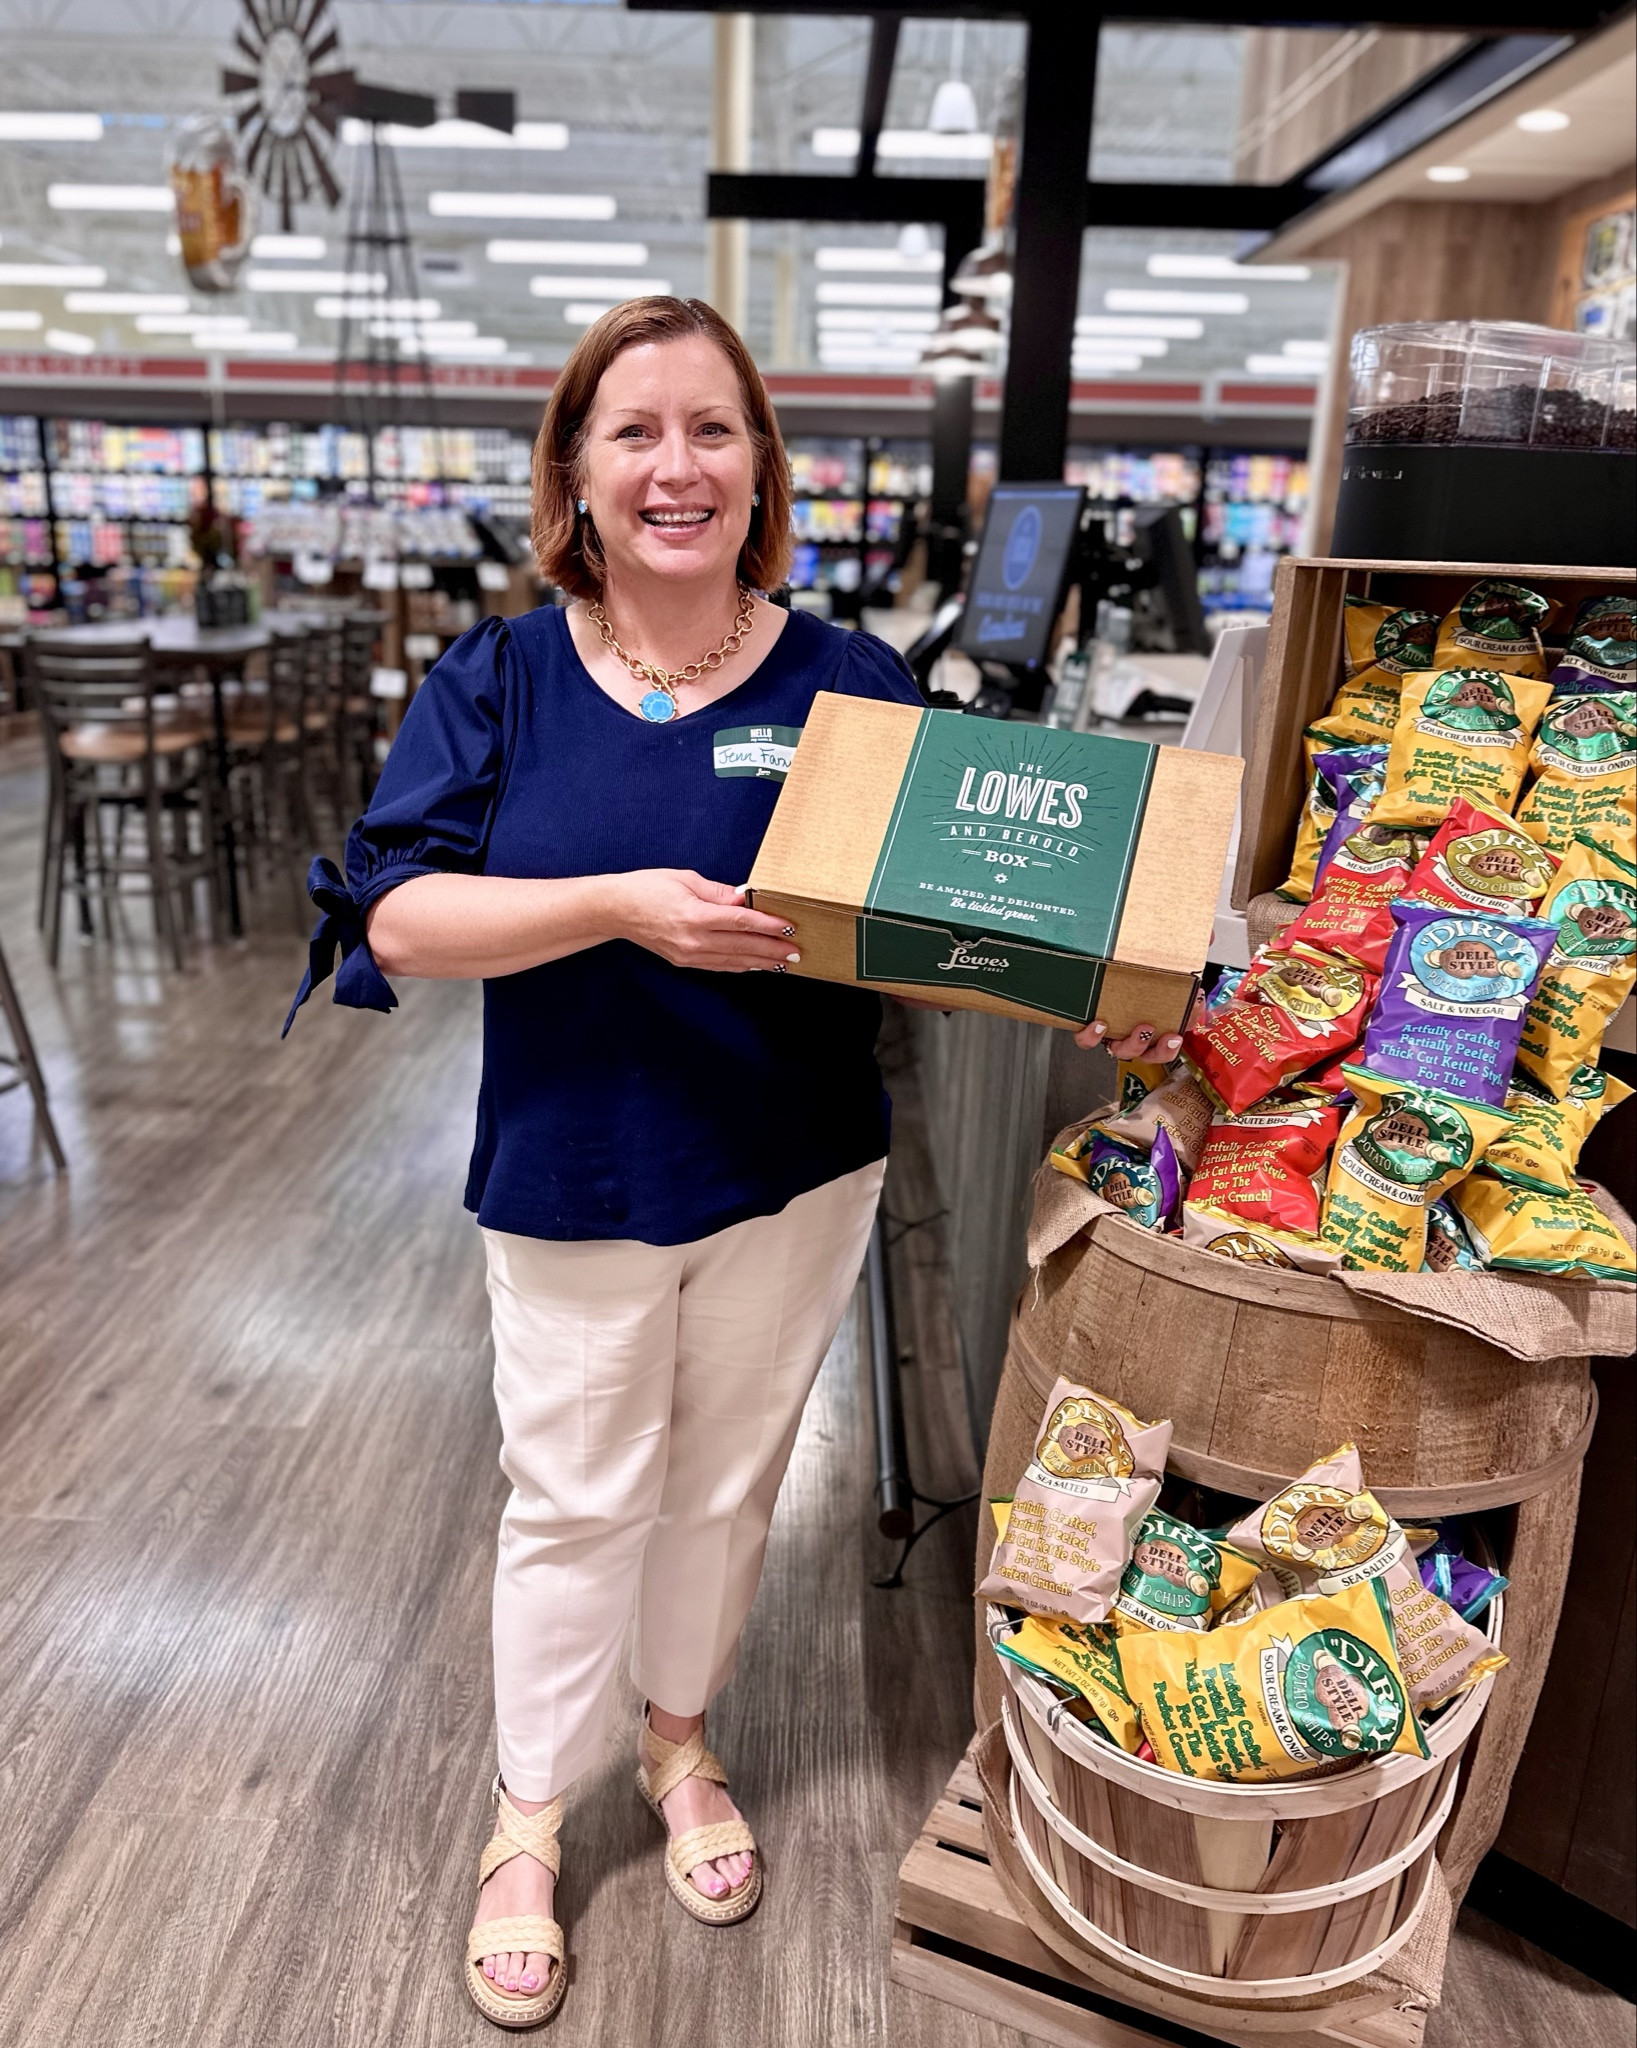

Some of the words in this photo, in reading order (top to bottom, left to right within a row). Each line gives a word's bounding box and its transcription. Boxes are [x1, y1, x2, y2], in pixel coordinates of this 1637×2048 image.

[1459, 636, 1481, 648] SOUR
[1481, 639, 1510, 652] CREAM
[1510, 644, 1518, 652] &
[1561, 655, 1580, 666] SALT
[1581, 663, 1589, 671] &
[1589, 665, 1628, 681] VINEGAR
[1475, 712, 1507, 726] CHIPS
[750, 728, 772, 738] HELLO
[1420, 724, 1444, 736] SOUR
[1445, 730, 1475, 744] CREAM
[1475, 735, 1482, 743] &
[1484, 736, 1512, 747] ONION
[718, 747, 757, 764] Jenn
[1413, 748, 1459, 766] Artfully
[1554, 735, 1593, 756] POTATO
[1019, 762, 1043, 774] THE
[1544, 756, 1566, 768] SOUR
[1567, 762, 1597, 774] CREAM
[1607, 757, 1637, 770] ONION
[955, 766, 1089, 829] LOWES
[950, 825, 987, 837] AND
[1002, 830, 1080, 857] BEHOLD
[984, 850, 1029, 868] BOX
[1346, 861, 1385, 874] MESQUITE
[1478, 862, 1520, 875] STYLE
[1485, 855, 1517, 865] DELI
[1455, 866, 1489, 890] POTATO
[1491, 882, 1526, 895] CHIPS
[918, 882, 934, 891] BE
[936, 885, 987, 900] AMAZED.
[990, 894, 1005, 903] BE
[1007, 897, 1078, 917] DELIGHTED.
[1328, 893, 1348, 904] Cut
[1444, 877, 1487, 904] MESQUITE
[1487, 900, 1510, 910] BBQ
[950, 896, 967, 909] Be
[967, 899, 1005, 916] tickled
[1002, 909, 1039, 923] green.
[1326, 905, 1345, 917] For
[1347, 907, 1367, 920] The
[1304, 918, 1339, 931] Perfect
[937, 947, 1010, 970] Lowes
[1449, 959, 1496, 970] STYLE
[1455, 950, 1490, 961] DELI
[1426, 970, 1470, 996] POTATO
[1472, 978, 1511, 997] CHIPS
[1420, 998, 1445, 1012] SALT
[1447, 1005, 1456, 1013] &
[1458, 1006, 1505, 1016] VINEGAR
[1221, 1026, 1239, 1043] The
[1402, 1024, 1451, 1040] Artfully
[1456, 1029, 1502, 1053] Crafted,
[1551, 1016, 1581, 1040] Style
[1208, 1033, 1243, 1067] Crunch!
[1254, 1039, 1278, 1064] Style
[1380, 1043, 1413, 1060] Thick
[1416, 1051, 1438, 1065] Cut
[1441, 1054, 1479, 1075] Kettle
[1400, 1034, 1451, 1055] Partially
[1455, 1043, 1498, 1067] Peeled,
[1416, 1066, 1440, 1081] For
[1444, 1071, 1466, 1088] The
[1378, 1129, 1426, 1149] STYLE
[1387, 1119, 1424, 1137] DELI
[1201, 1149, 1242, 1167] Partially
[1205, 1140, 1243, 1153] Artfully
[1357, 1137, 1392, 1171] POTATO
[1394, 1162, 1434, 1177] CHIPS
[1211, 1165, 1229, 1177] Cut
[1230, 1161, 1261, 1174] Kettle
[1262, 1161, 1287, 1181] Style
[1341, 1155, 1365, 1177] SOUR
[1363, 1171, 1392, 1197] CREAM
[1391, 1188, 1399, 1198] &
[1109, 1180, 1128, 1192] DELI
[1212, 1179, 1230, 1191] For
[1232, 1176, 1251, 1188] The
[1227, 1189, 1273, 1204] Crunch!
[1532, 1216, 1579, 1231] Perfect
[1551, 1205, 1575, 1217] For
[1576, 1207, 1595, 1220] The
[1368, 1211, 1413, 1242] Crafted,
[1322, 1225, 1346, 1245] Cut
[1343, 1236, 1381, 1264] Kettle
[1362, 1227, 1403, 1258] Peeled,
[1074, 1430, 1106, 1448] DELI
[1035, 1473, 1053, 1486] SEA
[1054, 1479, 1089, 1495] SALTED
[1012, 1498, 1048, 1520] Artfully
[1050, 1508, 1097, 1539] Crafted,
[1305, 1511, 1336, 1539] DELI
[1010, 1514, 1047, 1537] Partially
[1047, 1524, 1089, 1553] Peeled,
[1355, 1523, 1381, 1560] CHIPS
[1015, 1551, 1034, 1566] For
[1036, 1556, 1055, 1574] The
[1017, 1533, 1036, 1550] Cut
[1037, 1538, 1068, 1561] Kettle
[1070, 1552, 1102, 1574] Style
[1139, 1554, 1185, 1577] STYLE
[1148, 1545, 1182, 1564] DELI
[1341, 1571, 1363, 1588] SEA
[1363, 1551, 1396, 1578] SALTED
[1030, 1575, 1074, 1597] Crunch!
[1154, 1588, 1192, 1608] CHIPS
[1147, 1616, 1156, 1626] &
[1404, 1613, 1442, 1642] Kettle
[1399, 1648, 1422, 1669] For
[1420, 1634, 1444, 1655] The
[1427, 1633, 1470, 1670] Crunch!
[1052, 1658, 1065, 1669] NET
[1065, 1667, 1077, 1679] WT
[1075, 1674, 1080, 1682] 2
[1080, 1678, 1090, 1690] OZ
[1185, 1657, 1199, 1694] Thick
[1264, 1654, 1275, 1685] SOUR
[1220, 1662, 1247, 1719] Artfully
[1295, 1662, 1311, 1710] POTATO
[1336, 1678, 1363, 1714] DELI
[1154, 1681, 1172, 1732] Perfect
[1191, 1694, 1208, 1724] Cut
[1202, 1667, 1229, 1730] Partially
[1266, 1686, 1284, 1725] CREAM
[1321, 1678, 1354, 1723] STYLE
[1257, 1701, 1268, 1727] FLAVORED
[1177, 1704, 1192, 1729] For
[1186, 1729, 1203, 1758] The
[1278, 1724, 1286, 1733] &
[1300, 1712, 1337, 1748] CHIPS
[1201, 1722, 1223, 1767] Kettle
